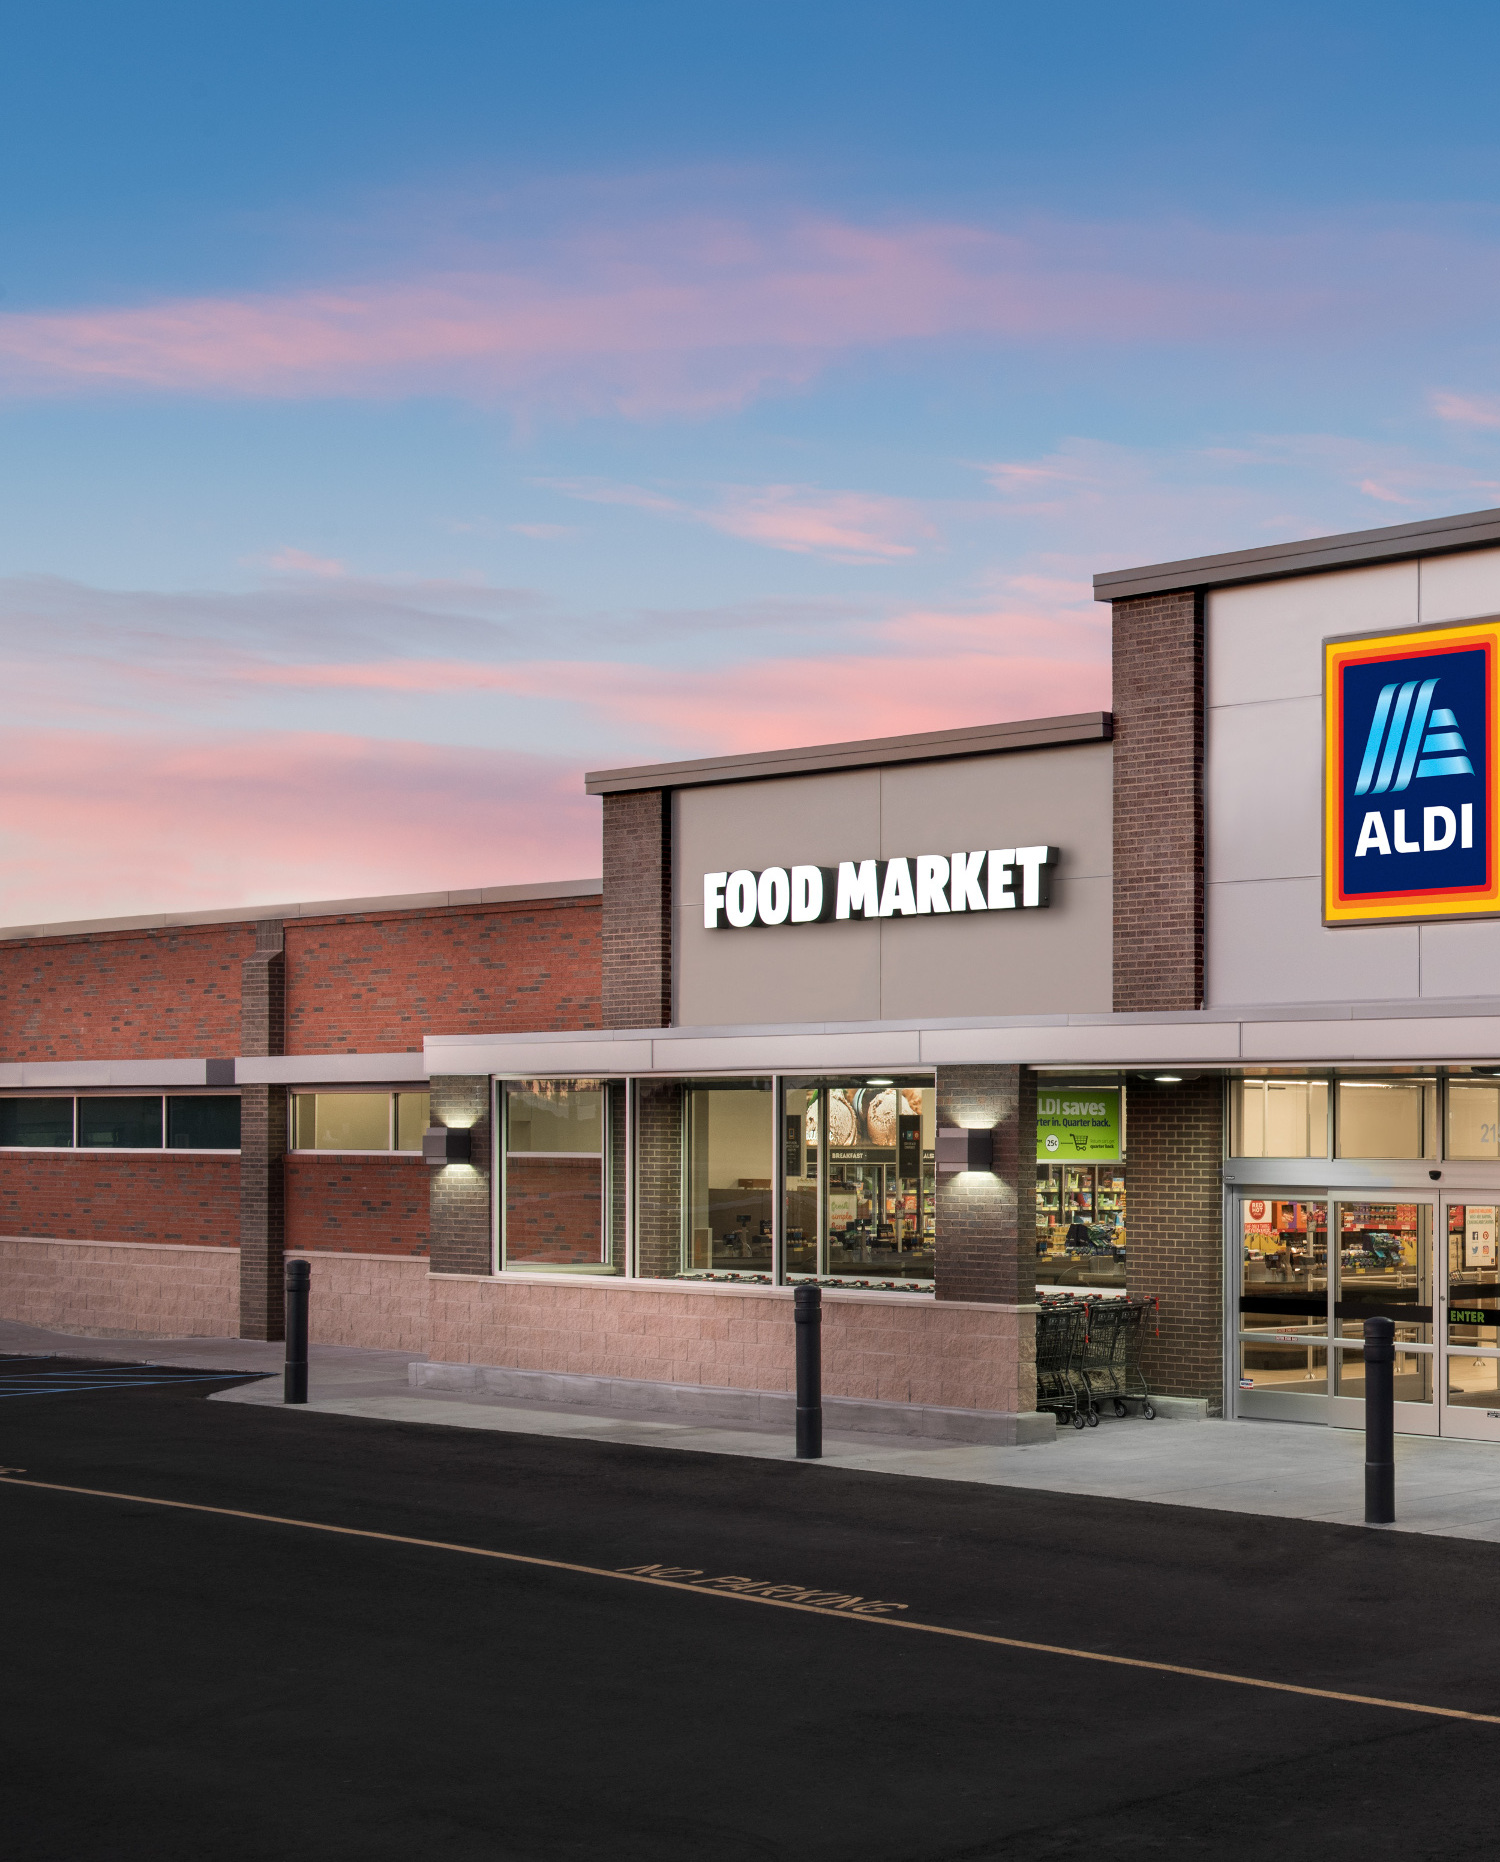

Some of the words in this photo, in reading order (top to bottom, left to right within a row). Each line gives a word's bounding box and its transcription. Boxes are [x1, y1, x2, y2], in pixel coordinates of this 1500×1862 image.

[1354, 803, 1473, 857] ALDI
[703, 864, 824, 929] FOOD
[835, 845, 1049, 920] MARKET
[1037, 1098, 1061, 1115] LDI
[1062, 1101, 1106, 1116] saves
[1052, 1117, 1061, 1126] in.
[1062, 1118, 1091, 1128] Quarter
[1092, 1118, 1111, 1127] back.
[831, 1211, 853, 1220] simple
[1450, 1310, 1485, 1323] ENTER
[616, 1563, 704, 1578] NO
[691, 1575, 909, 1613] PARKING
